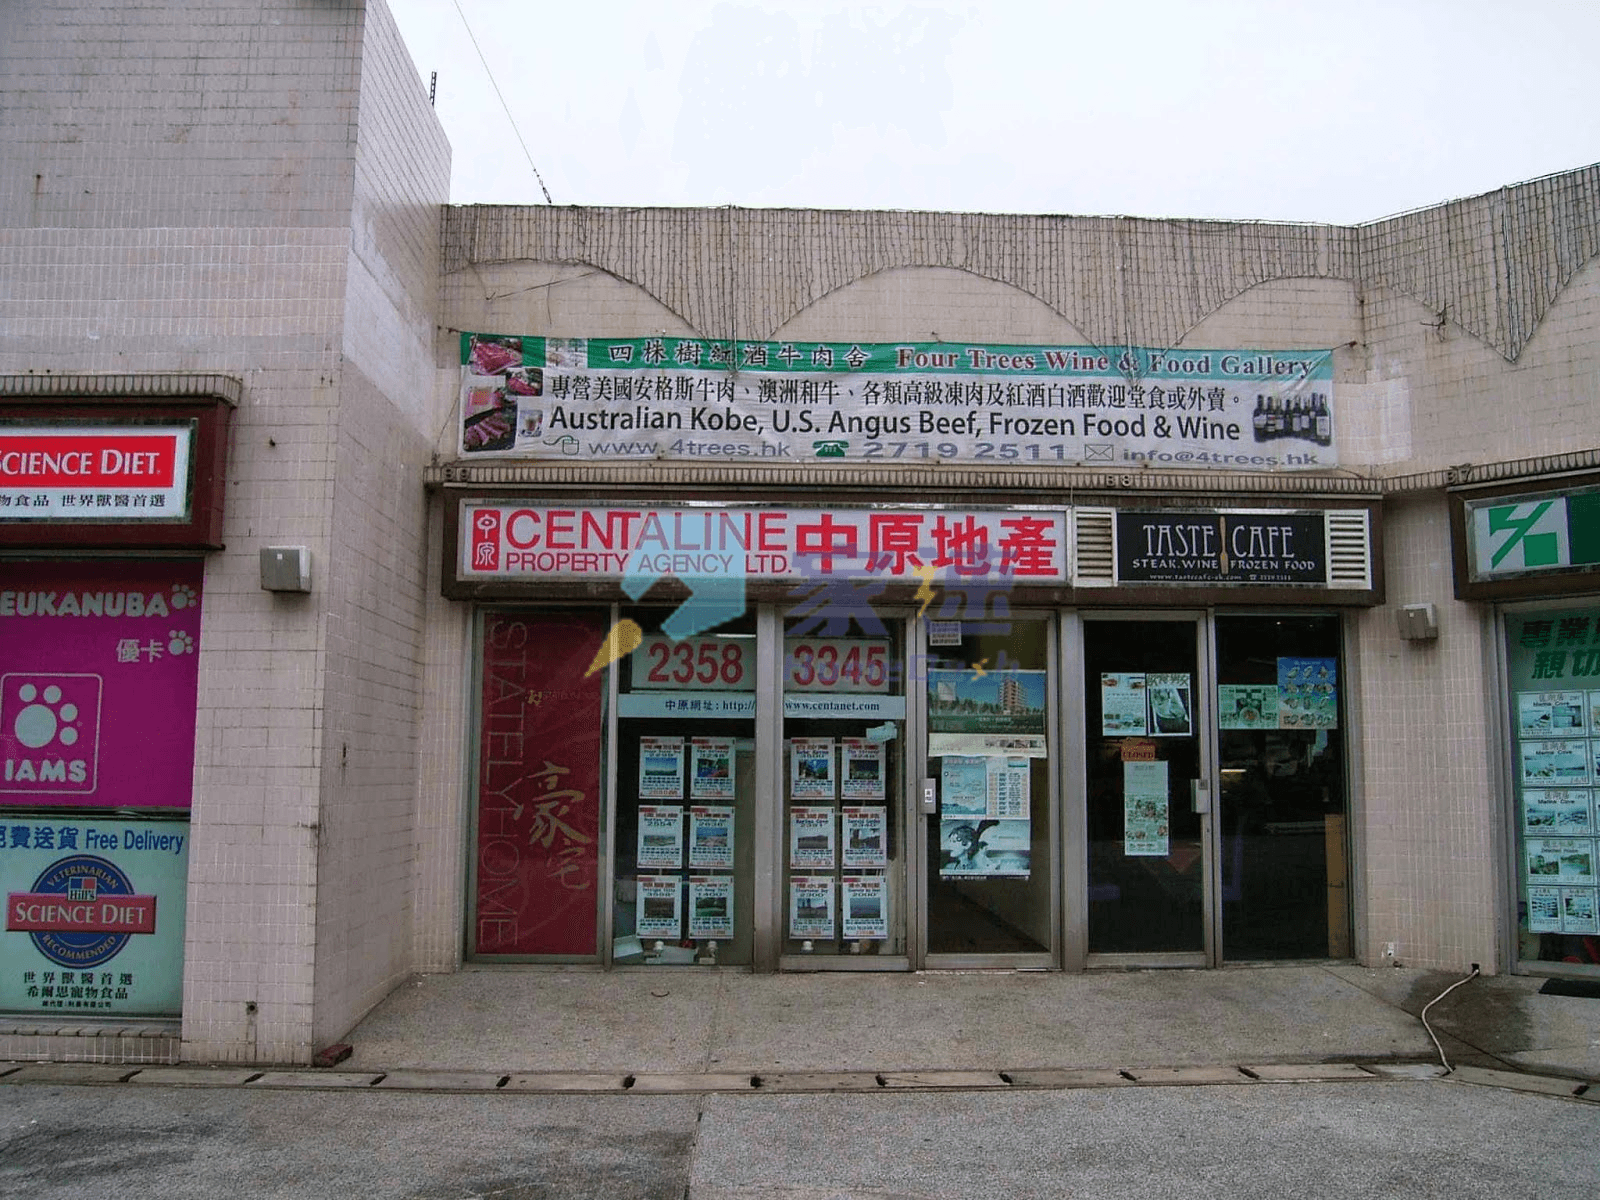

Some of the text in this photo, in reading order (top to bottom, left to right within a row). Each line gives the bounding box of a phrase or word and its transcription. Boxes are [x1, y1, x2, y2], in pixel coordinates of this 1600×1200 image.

[896, 346, 1313, 379] Four Trees Wine & Food Gallery
[549, 406, 1240, 441] Australian Kobe, U.S. Angus Beef, Frozen Food & Wine
[588, 438, 790, 457] www.4trees.hk
[863, 442, 1066, 461] 2719 2511
[1123, 447, 1318, 466] info@4trees.hk
[0, 452, 93, 475] CIENCE
[62, 494, 166, 508] 世界獸醫首選
[505, 509, 788, 551] CENTALINE
[796, 513, 1059, 577] 中原地產
[1142, 525, 1295, 559] TASTE CAFE
[506, 553, 792, 574] PROPERTY AGENCY LTD.
[1231, 560, 1279, 570] FROZEN
[1285, 561, 1315, 570] FOOD
[0, 591, 169, 617] EUKANUBA
[648, 642, 887, 687] 2358 3345
[723, 700, 756, 711] http://
[785, 702, 880, 711] www.centanet.com
[5, 759, 87, 783] IAMS
[86, 829, 118, 850] Free
[124, 829, 184, 855] Delivery
[47, 864, 119, 890] VETERINARIAN
[69, 888, 95, 901] Hill's
[15, 902, 146, 925] SCIENCE DIET
[42, 934, 117, 961] RECOMMENDED
[24, 971, 133, 986] 世界獸醫首選
[27, 986, 128, 1000] 希爾思寵物食品
